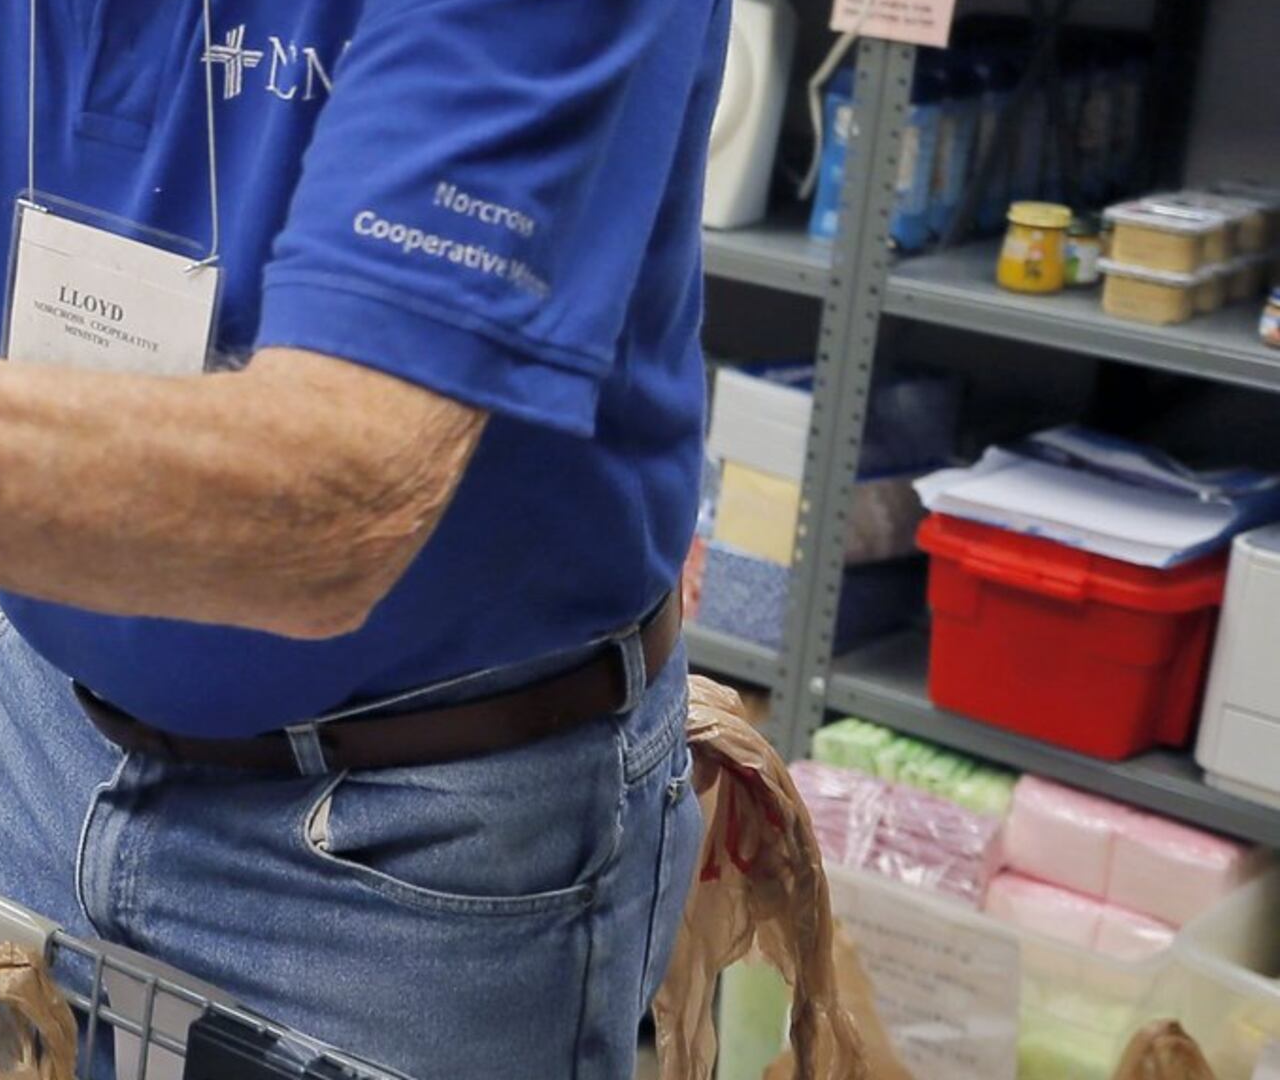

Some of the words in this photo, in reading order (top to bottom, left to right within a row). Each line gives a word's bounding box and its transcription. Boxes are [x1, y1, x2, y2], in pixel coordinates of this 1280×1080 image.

[353, 210, 507, 277] Cooperative
[58, 285, 124, 322] LLOYD
[33, 300, 86, 325] NORCROSS
[90, 321, 159, 353] COOPERATIVE
[64, 324, 111, 349] MINISTRY
